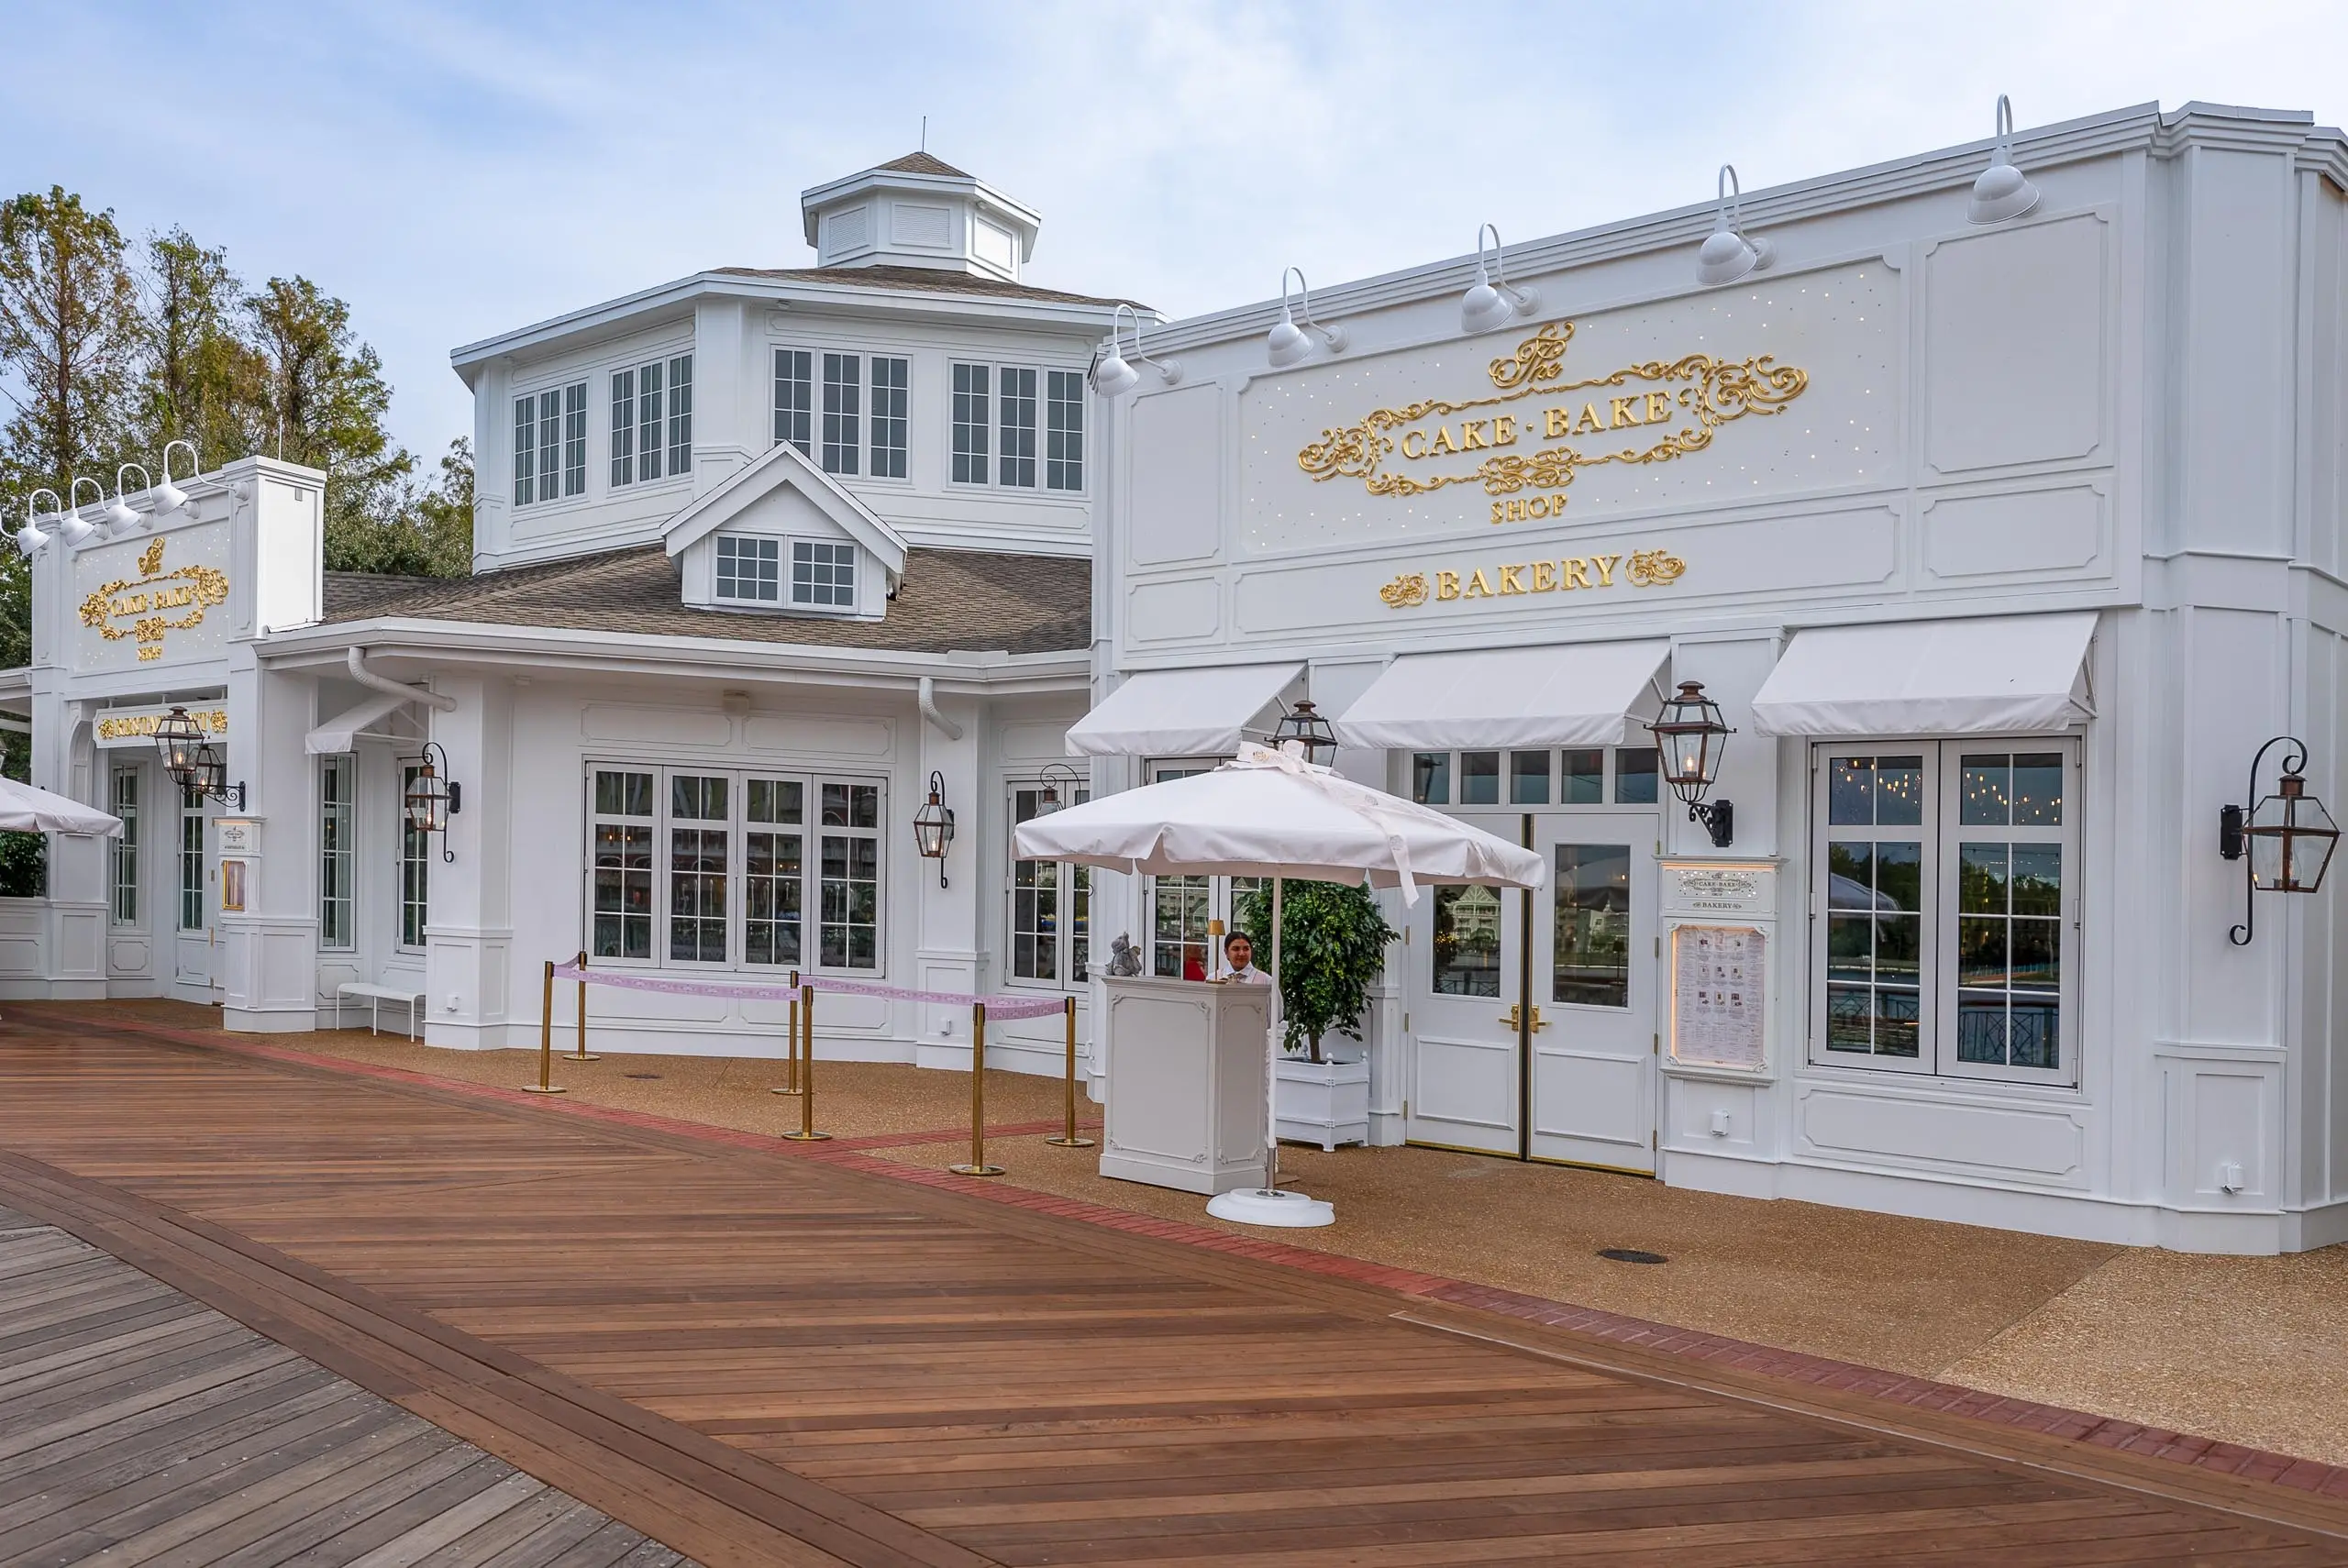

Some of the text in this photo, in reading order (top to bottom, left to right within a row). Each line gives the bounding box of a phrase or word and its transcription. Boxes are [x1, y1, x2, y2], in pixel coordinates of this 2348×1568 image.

[1489, 321, 1576, 389] The
[1401, 390, 1672, 459] CAKE BAKE
[1491, 493, 1567, 524] SHOP
[1435, 554, 1622, 601] BAKERY
